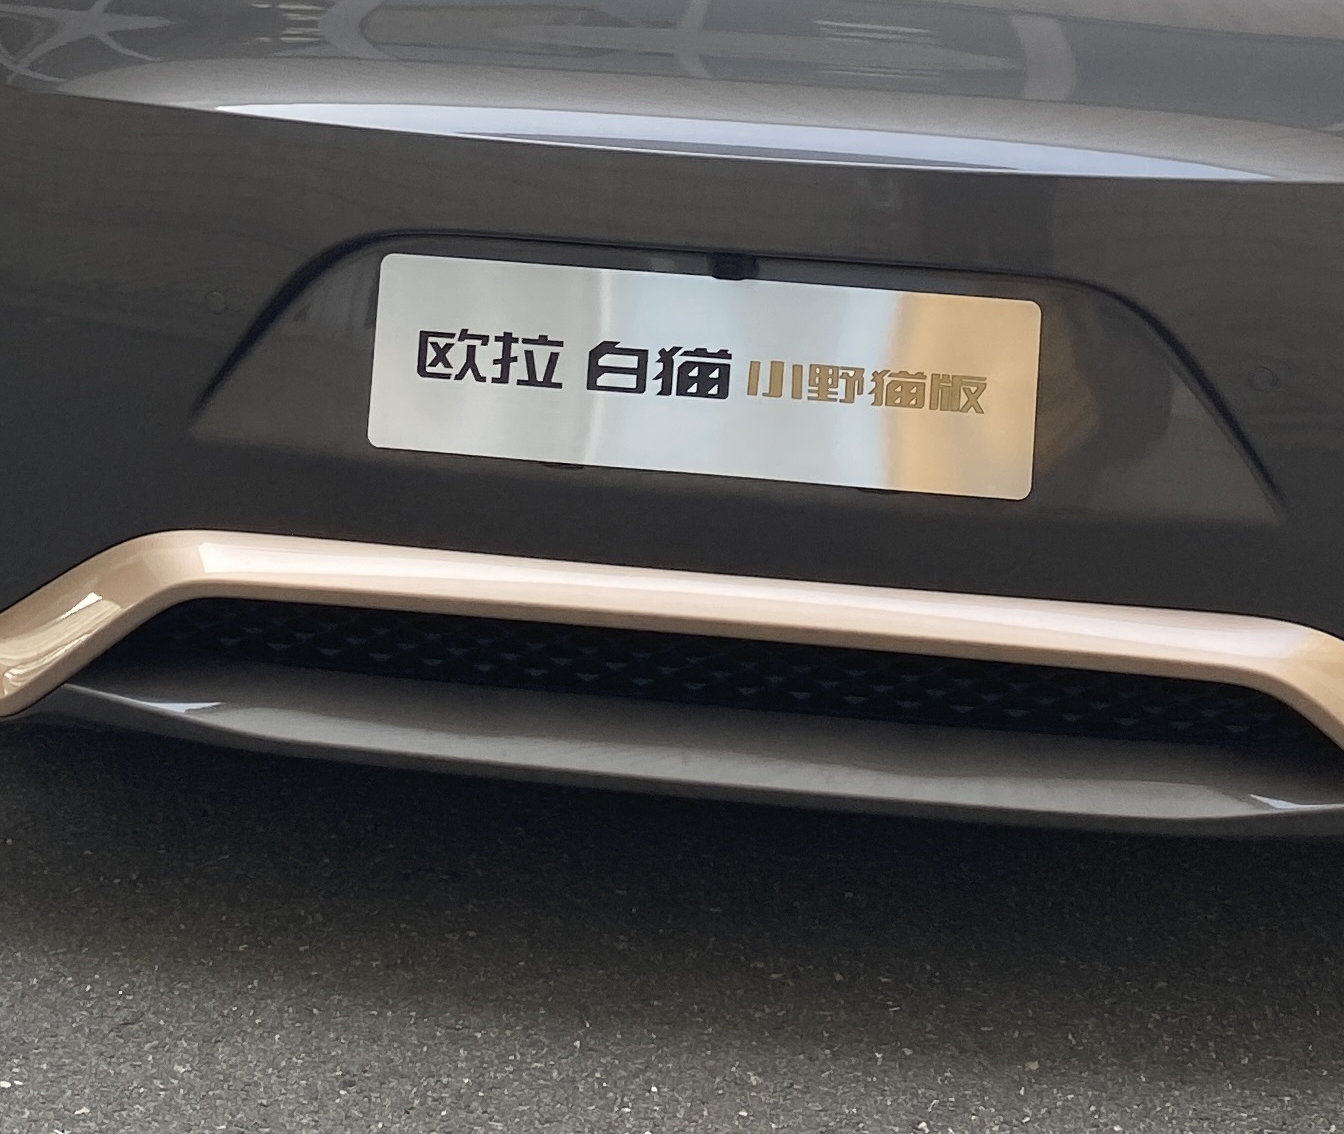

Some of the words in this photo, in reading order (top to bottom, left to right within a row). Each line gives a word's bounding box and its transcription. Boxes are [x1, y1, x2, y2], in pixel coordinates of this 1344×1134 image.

[416, 328, 565, 389] 欧拉
[586, 340, 733, 400] 白猫
[746, 360, 988, 414] 小野猫版
